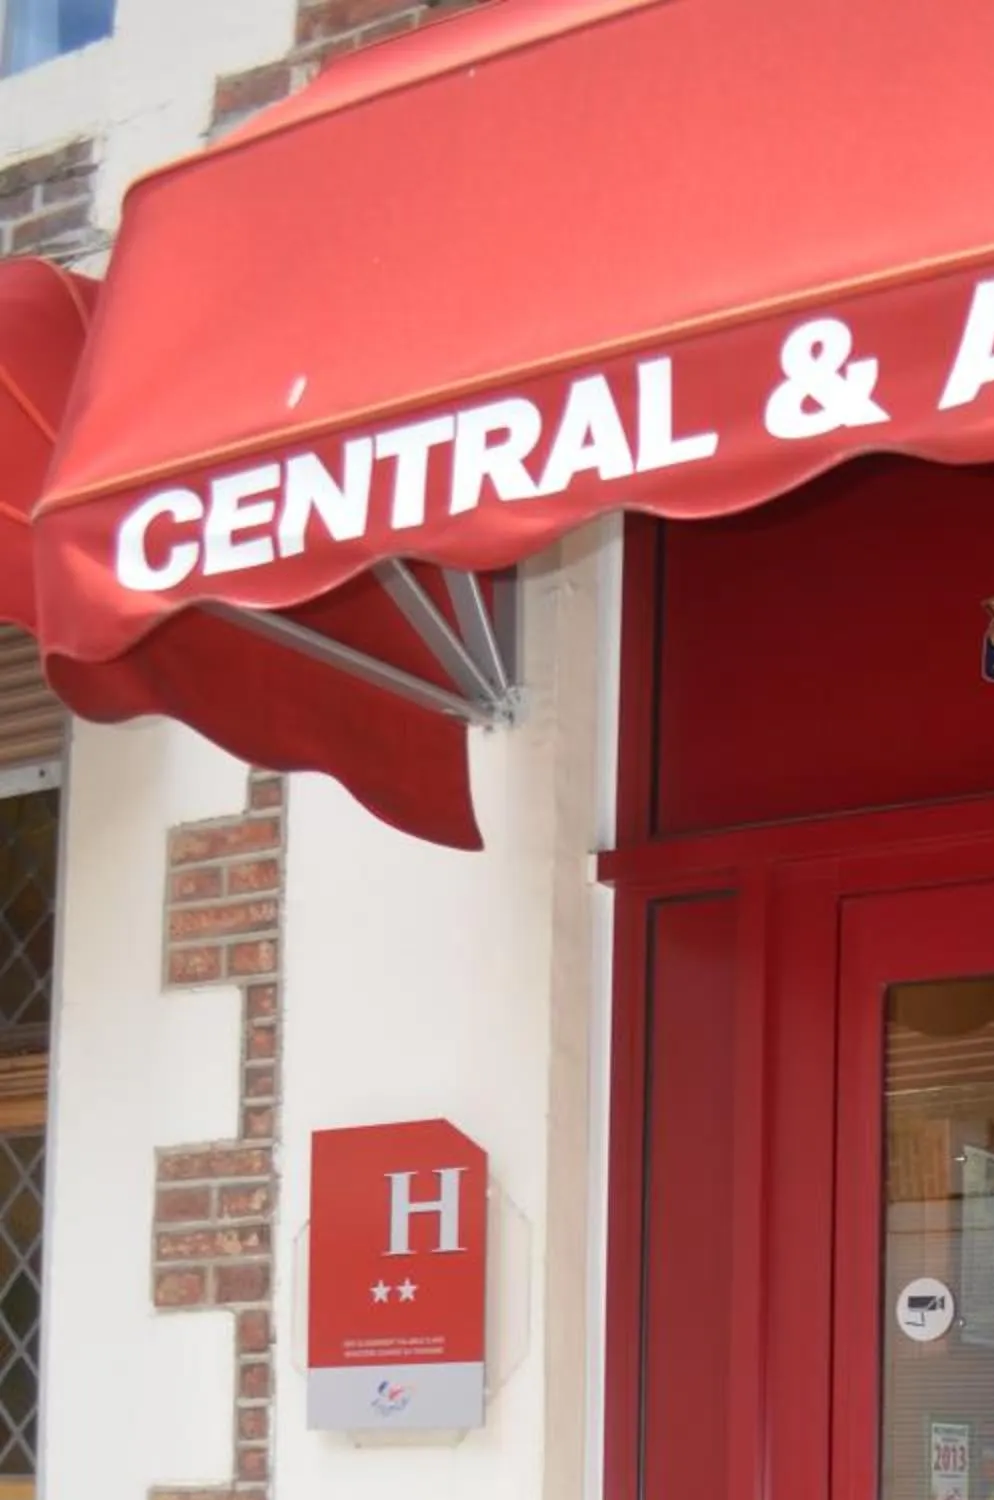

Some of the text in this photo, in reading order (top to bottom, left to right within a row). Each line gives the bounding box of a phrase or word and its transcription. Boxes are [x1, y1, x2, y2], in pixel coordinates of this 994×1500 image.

[116, 357, 718, 592] CENTRAL
[764, 318, 890, 439] &
[382, 1167, 470, 1257] H
